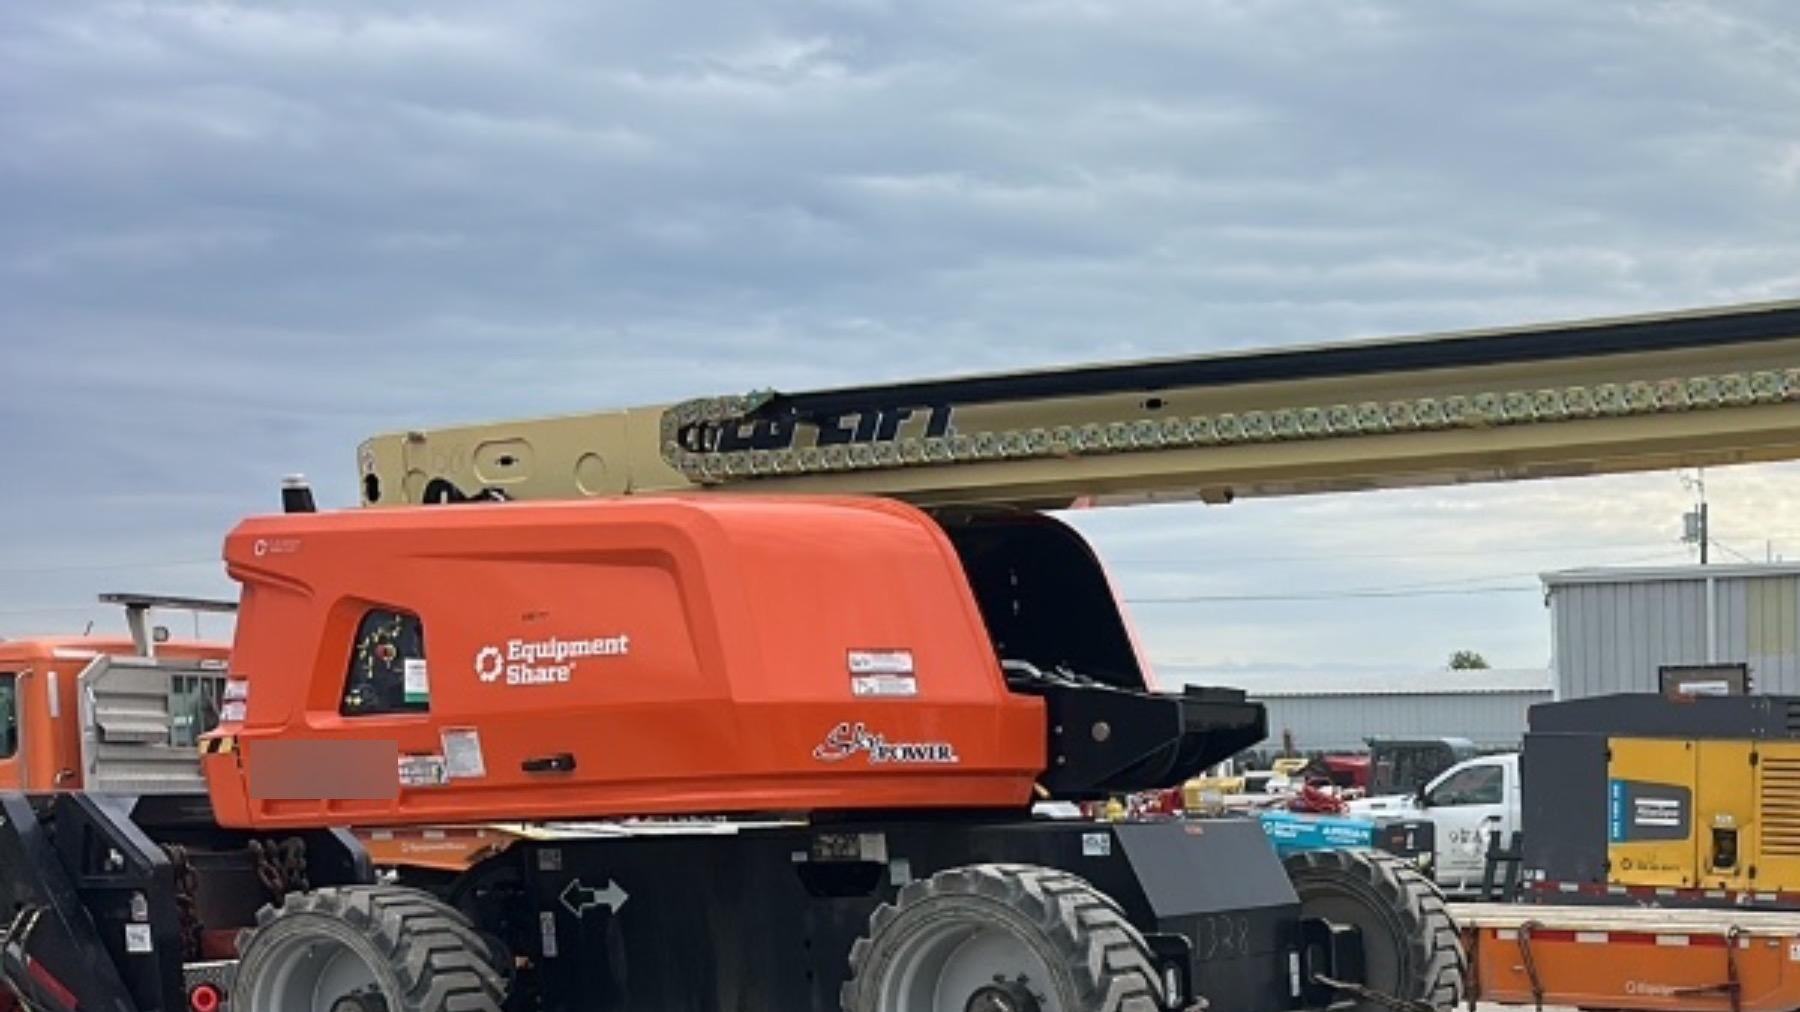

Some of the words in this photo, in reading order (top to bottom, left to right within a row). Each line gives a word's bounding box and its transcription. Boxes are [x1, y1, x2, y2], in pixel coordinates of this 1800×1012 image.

[506, 635, 629, 664] Equipment
[506, 663, 571, 685] Share
[870, 743, 952, 765] POWER
